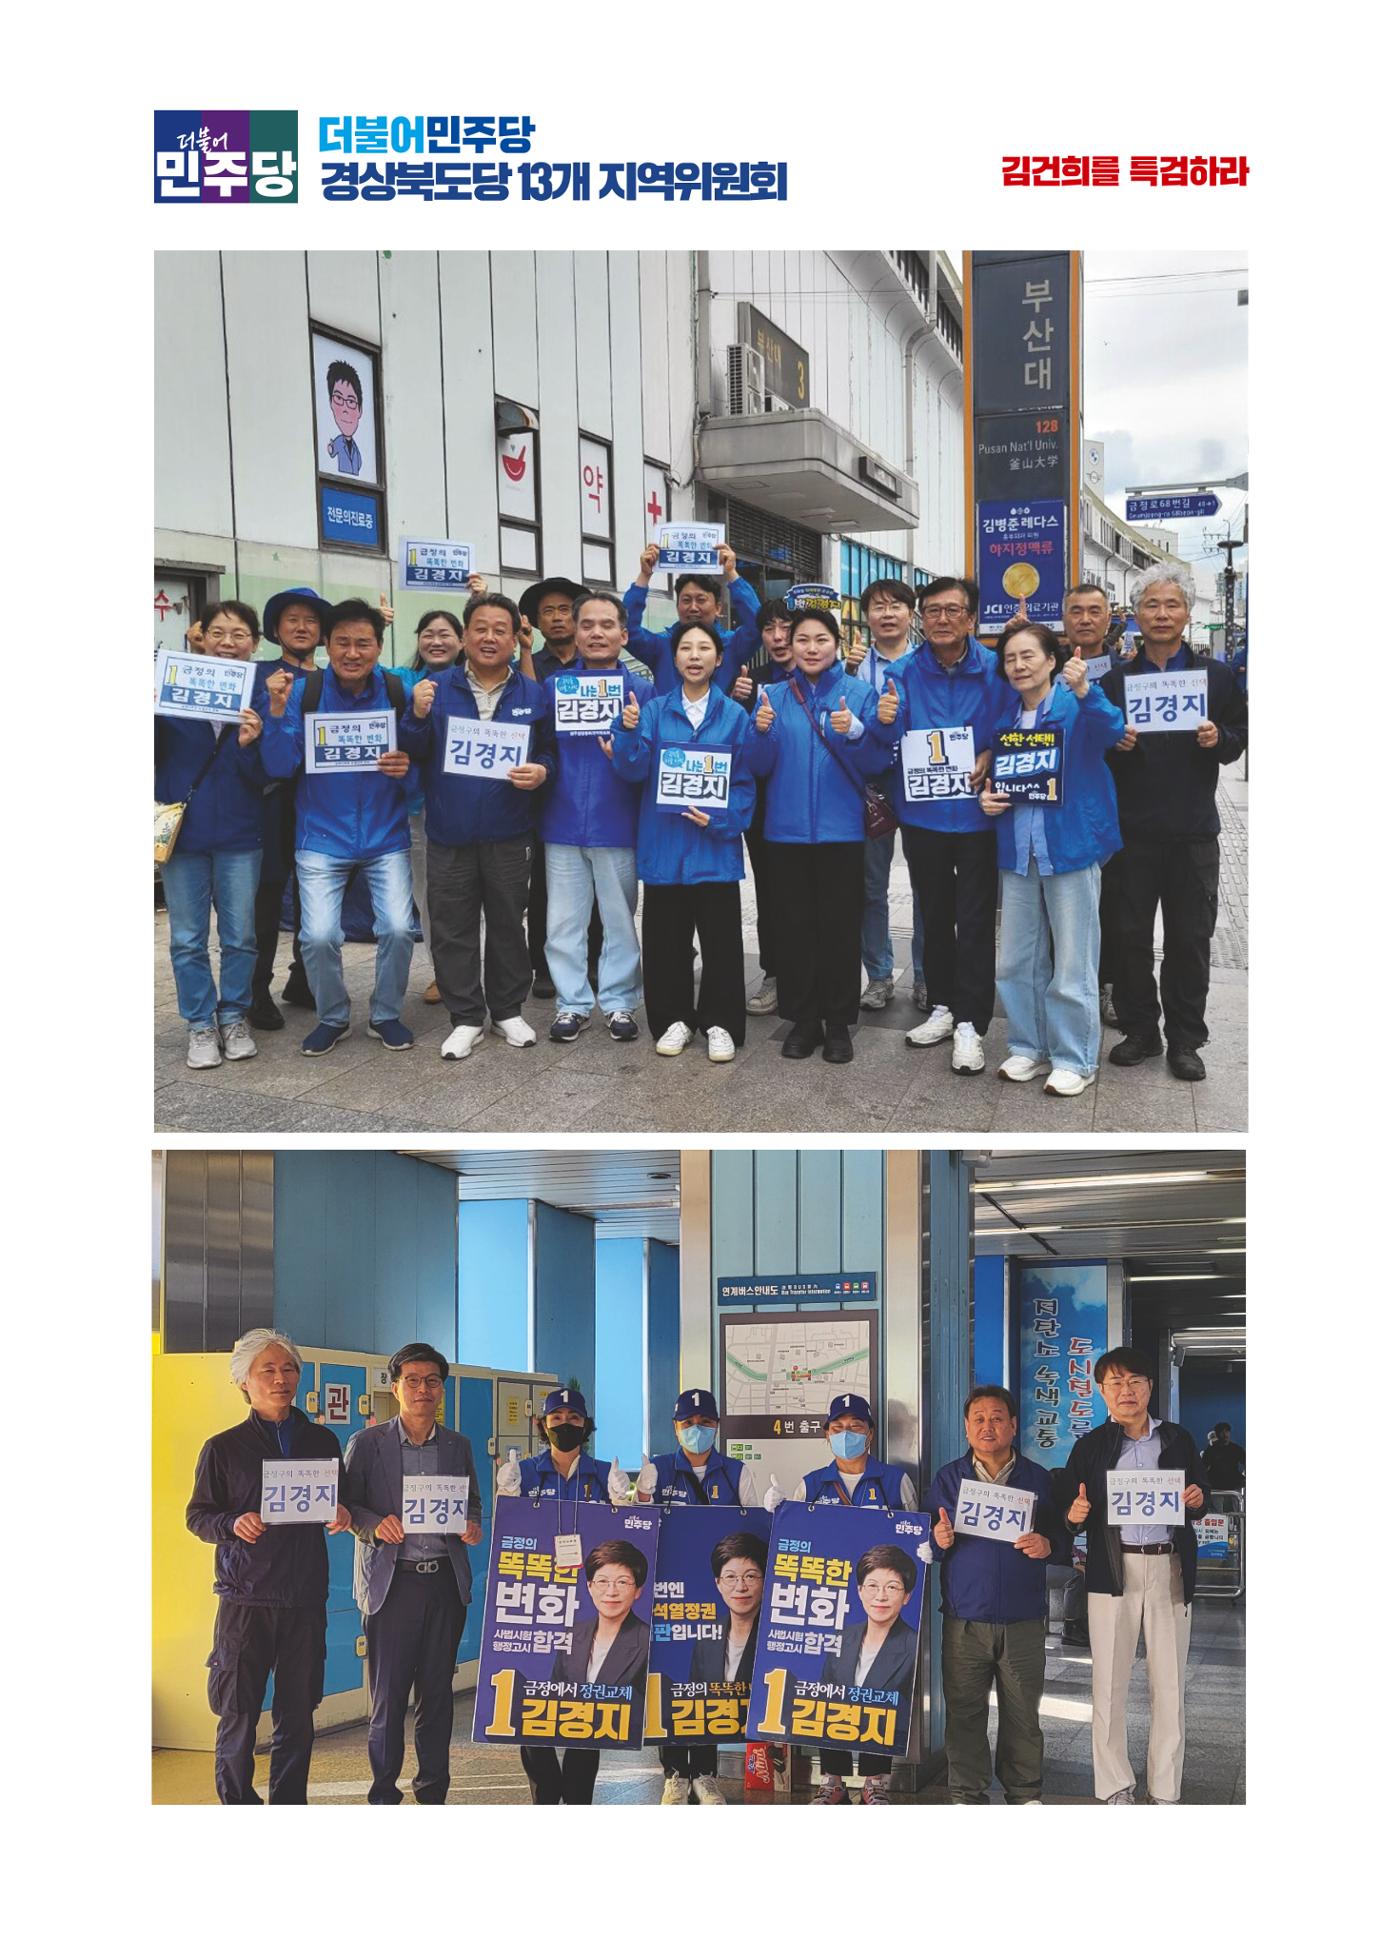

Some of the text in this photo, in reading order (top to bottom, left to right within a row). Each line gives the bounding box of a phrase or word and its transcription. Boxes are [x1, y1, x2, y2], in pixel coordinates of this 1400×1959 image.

[1022, 279, 1054, 390] 부산대
[797, 361, 805, 399] 3
[1035, 420, 1059, 433] 128
[979, 438, 1058, 455] Pusan Nat'l Univ.
[583, 465, 604, 514] 약
[327, 506, 373, 529] 전문의진료중
[666, 551, 712, 565] 김경지
[414, 568, 463, 582] 김경지
[984, 605, 1003, 615] JCI
[171, 688, 233, 708] 김경지
[581, 685, 597, 697] 나는
[558, 698, 622, 723] 김경지
[1129, 693, 1206, 723] 김경지
[317, 726, 328, 746] 1
[329, 723, 361, 734] 금정의
[926, 730, 950, 766] 1
[1000, 732, 1025, 747] 선한
[324, 746, 381, 761] 김경지
[450, 740, 521, 769] 김경지
[995, 748, 1058, 777] 김경지
[686, 760, 703, 772] 나는
[660, 771, 728, 800] 김경지
[908, 772, 976, 798] 김경지
[1047, 778, 1058, 801] 1
[722, 1285, 778, 1296] 연계버스안내도
[327, 1387, 349, 1420] 관
[560, 1390, 569, 1403] 1
[691, 1392, 700, 1406] 1
[842, 1395, 850, 1407] 1
[799, 1420, 821, 1433] 출구
[264, 1484, 336, 1512] 김경지
[711, 1485, 719, 1499] 1
[868, 1488, 877, 1500] 1
[1111, 1491, 1179, 1516] 김경지
[624, 1519, 652, 1530] 민주당
[961, 1501, 1026, 1532] 김경지
[895, 1523, 923, 1535] 민주당
[501, 1535, 537, 1550] 금정의
[778, 1538, 811, 1553] 금정의
[774, 1553, 852, 1587] 똑똑한
[495, 1581, 580, 1627] 변화
[770, 1583, 849, 1630] 변화
[494, 1629, 532, 1642] 사법시험
[533, 1630, 574, 1655] 합격
[768, 1629, 803, 1642] 사법시험
[804, 1631, 843, 1657] 합격
[492, 1641, 531, 1653] 행정고시
[766, 1641, 803, 1654] 행정고시
[523, 1680, 633, 1701] 금정에서 정권교체
[670, 1681, 746, 1697] 금정의 똑똑한
[794, 1680, 900, 1707] 금정에서 정권교체
[485, 1669, 516, 1737] 1
[757, 1668, 787, 1735] 1
[521, 1698, 632, 1741] 김경지
[791, 1698, 897, 1746] 김경지
